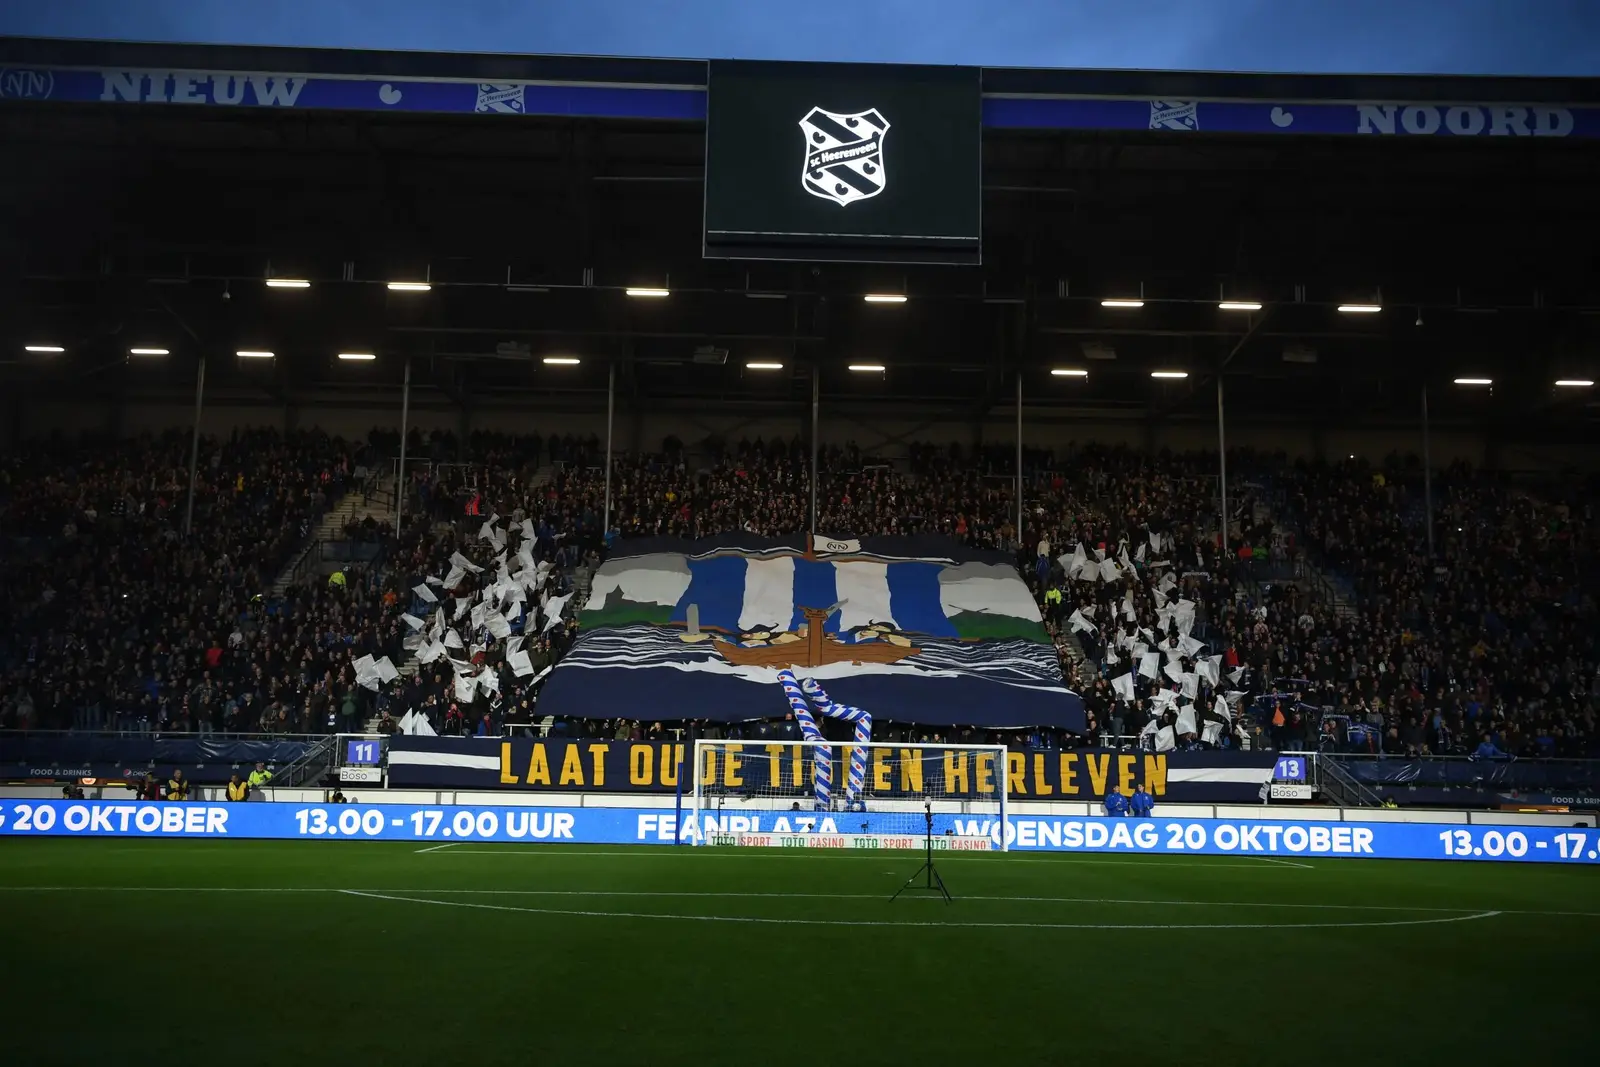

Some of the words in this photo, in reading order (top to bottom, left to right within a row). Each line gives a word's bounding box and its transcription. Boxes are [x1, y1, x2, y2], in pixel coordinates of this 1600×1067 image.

[100, 71, 305, 107] NIEUW
[1357, 104, 1575, 137] NOORD
[810, 157, 821, 167] sc
[821, 142, 877, 163] Heerenveen
[355, 743, 373, 762] 11
[62, 769, 92, 777] DRINKS
[500, 742, 610, 787] LAAT
[629, 743, 744, 787] OUDE
[764, 743, 923, 792] TIEN
[943, 750, 1168, 797] HERLEVEN
[1279, 759, 1300, 778] 13
[1552, 796, 1574, 804] FOOD
[13, 804, 57, 831] 20
[63, 805, 229, 833] OKTOBER
[295, 808, 385, 836] 13.00
[391, 818, 404, 827] -
[410, 810, 499, 838] 17.00
[506, 812, 575, 838] UUR
[741, 836, 771, 847] SPORT
[780, 836, 805, 847] TOTO
[810, 837, 845, 848] CASINO
[853, 837, 878, 849] TOTO
[883, 838, 913, 849] SPORT
[951, 840, 986, 850] CASINO
[954, 819, 1159, 849] WOENSDAG
[1165, 823, 1207, 850] 20
[1213, 824, 1374, 853] OKTOBER
[1439, 829, 1529, 858] 13.00
[1553, 833, 1600, 859] 17.
